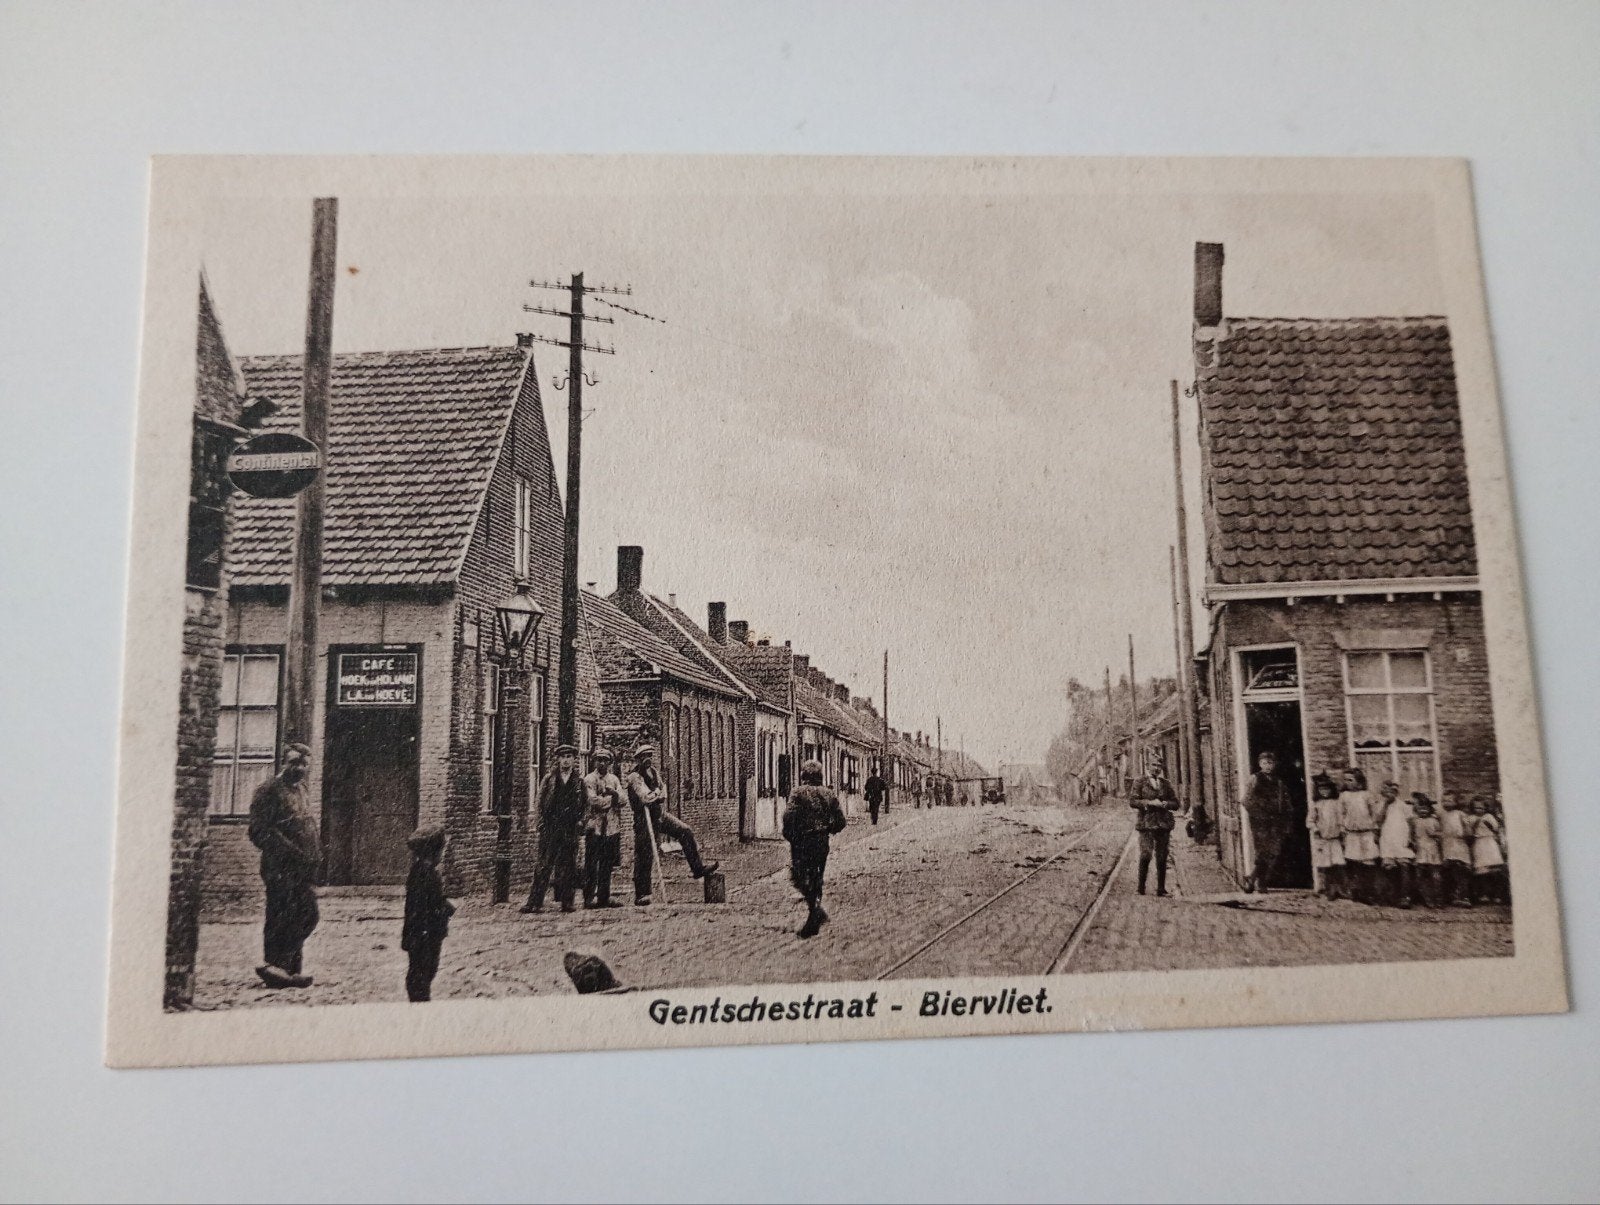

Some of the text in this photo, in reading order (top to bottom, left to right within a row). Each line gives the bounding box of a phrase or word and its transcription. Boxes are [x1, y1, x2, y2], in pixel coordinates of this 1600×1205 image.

[235, 453, 318, 471] Continental
[648, 992, 878, 1025] Gentschestraat
[919, 987, 1053, 1017] Biervliet.
